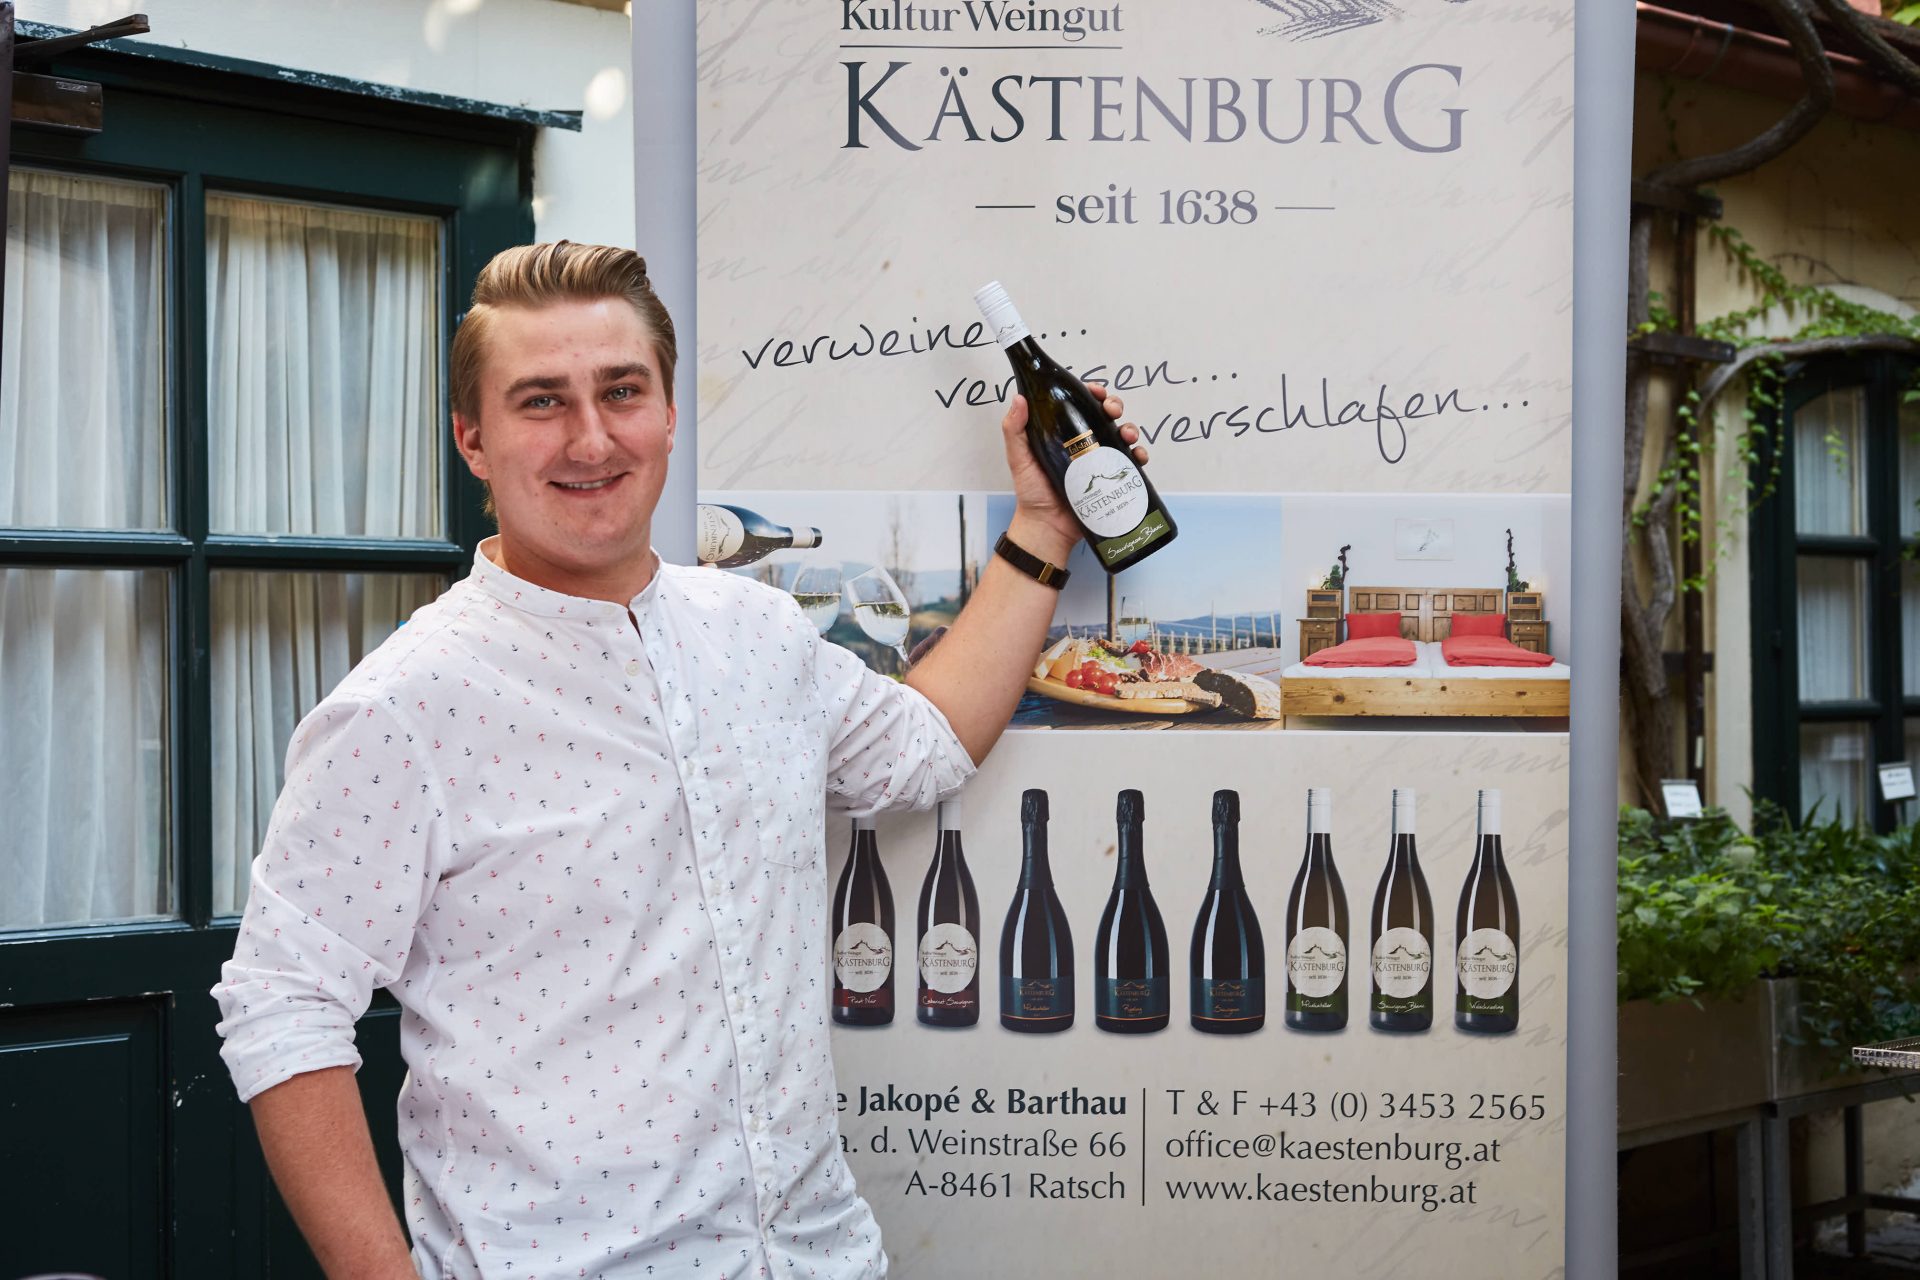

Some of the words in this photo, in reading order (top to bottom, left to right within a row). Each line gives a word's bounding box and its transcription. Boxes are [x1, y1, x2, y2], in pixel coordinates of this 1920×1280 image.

[839, 61, 1468, 153] KÄSTENBURG
[1056, 184, 1138, 224] seit
[1160, 190, 1257, 224] 1638
[1077, 475, 1142, 520] KÄSTENBURG
[858, 1084, 960, 1121] Jakopé
[971, 1088, 995, 1113] &
[1008, 1087, 1126, 1115] Barthau
[1166, 1090, 1185, 1115] T
[1197, 1091, 1219, 1115] &
[1233, 1090, 1247, 1115] F
[1260, 1092, 1316, 1117] +43
[1331, 1092, 1367, 1121] (0)
[1380, 1093, 1454, 1118] 3453
[1468, 1094, 1545, 1120] 2565
[871, 1126, 896, 1153] d.
[908, 1129, 1077, 1157] Weinstraße
[1090, 1132, 1126, 1157] 66
[1166, 1130, 1501, 1170] office@kaestenburg.at
[905, 1170, 1010, 1197] A-8461
[1030, 1172, 1124, 1199] Ratsch
[1166, 1173, 1477, 1212] www.kaestenburg.at
